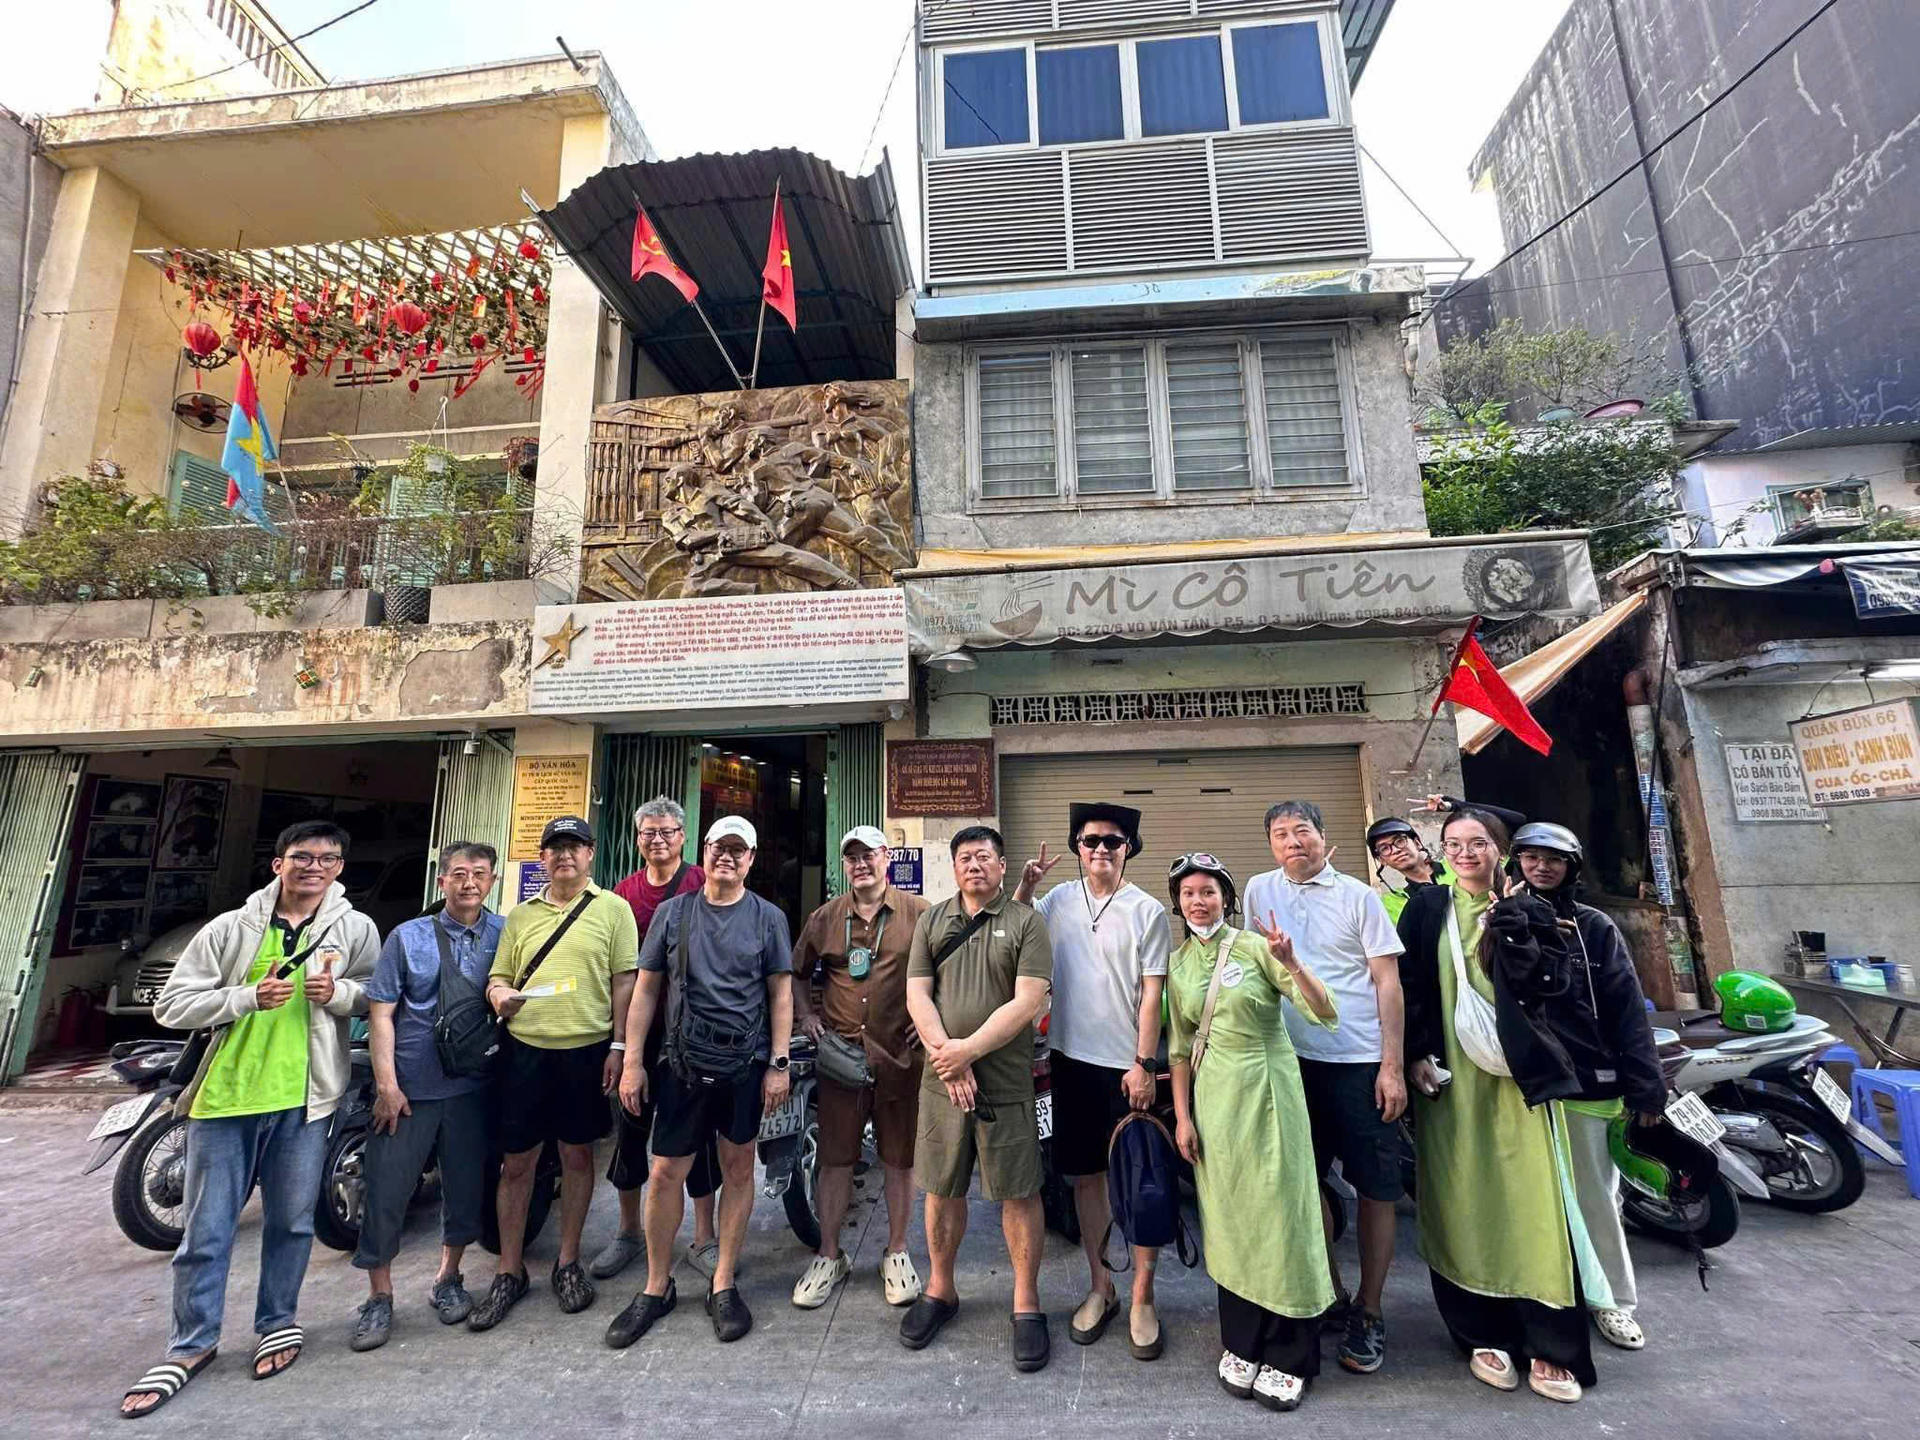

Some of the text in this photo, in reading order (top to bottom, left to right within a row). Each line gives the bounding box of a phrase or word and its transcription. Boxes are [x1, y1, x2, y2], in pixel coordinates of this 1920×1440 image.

[1066, 557, 1435, 615] Mì Cô Tiên
[1739, 747, 1766, 762] TẠI
[1733, 764, 1749, 779] CÓ
[1751, 764, 1775, 778] BÁN
[1815, 776, 1844, 789] CUA
[888, 848, 919, 862] 287/70
